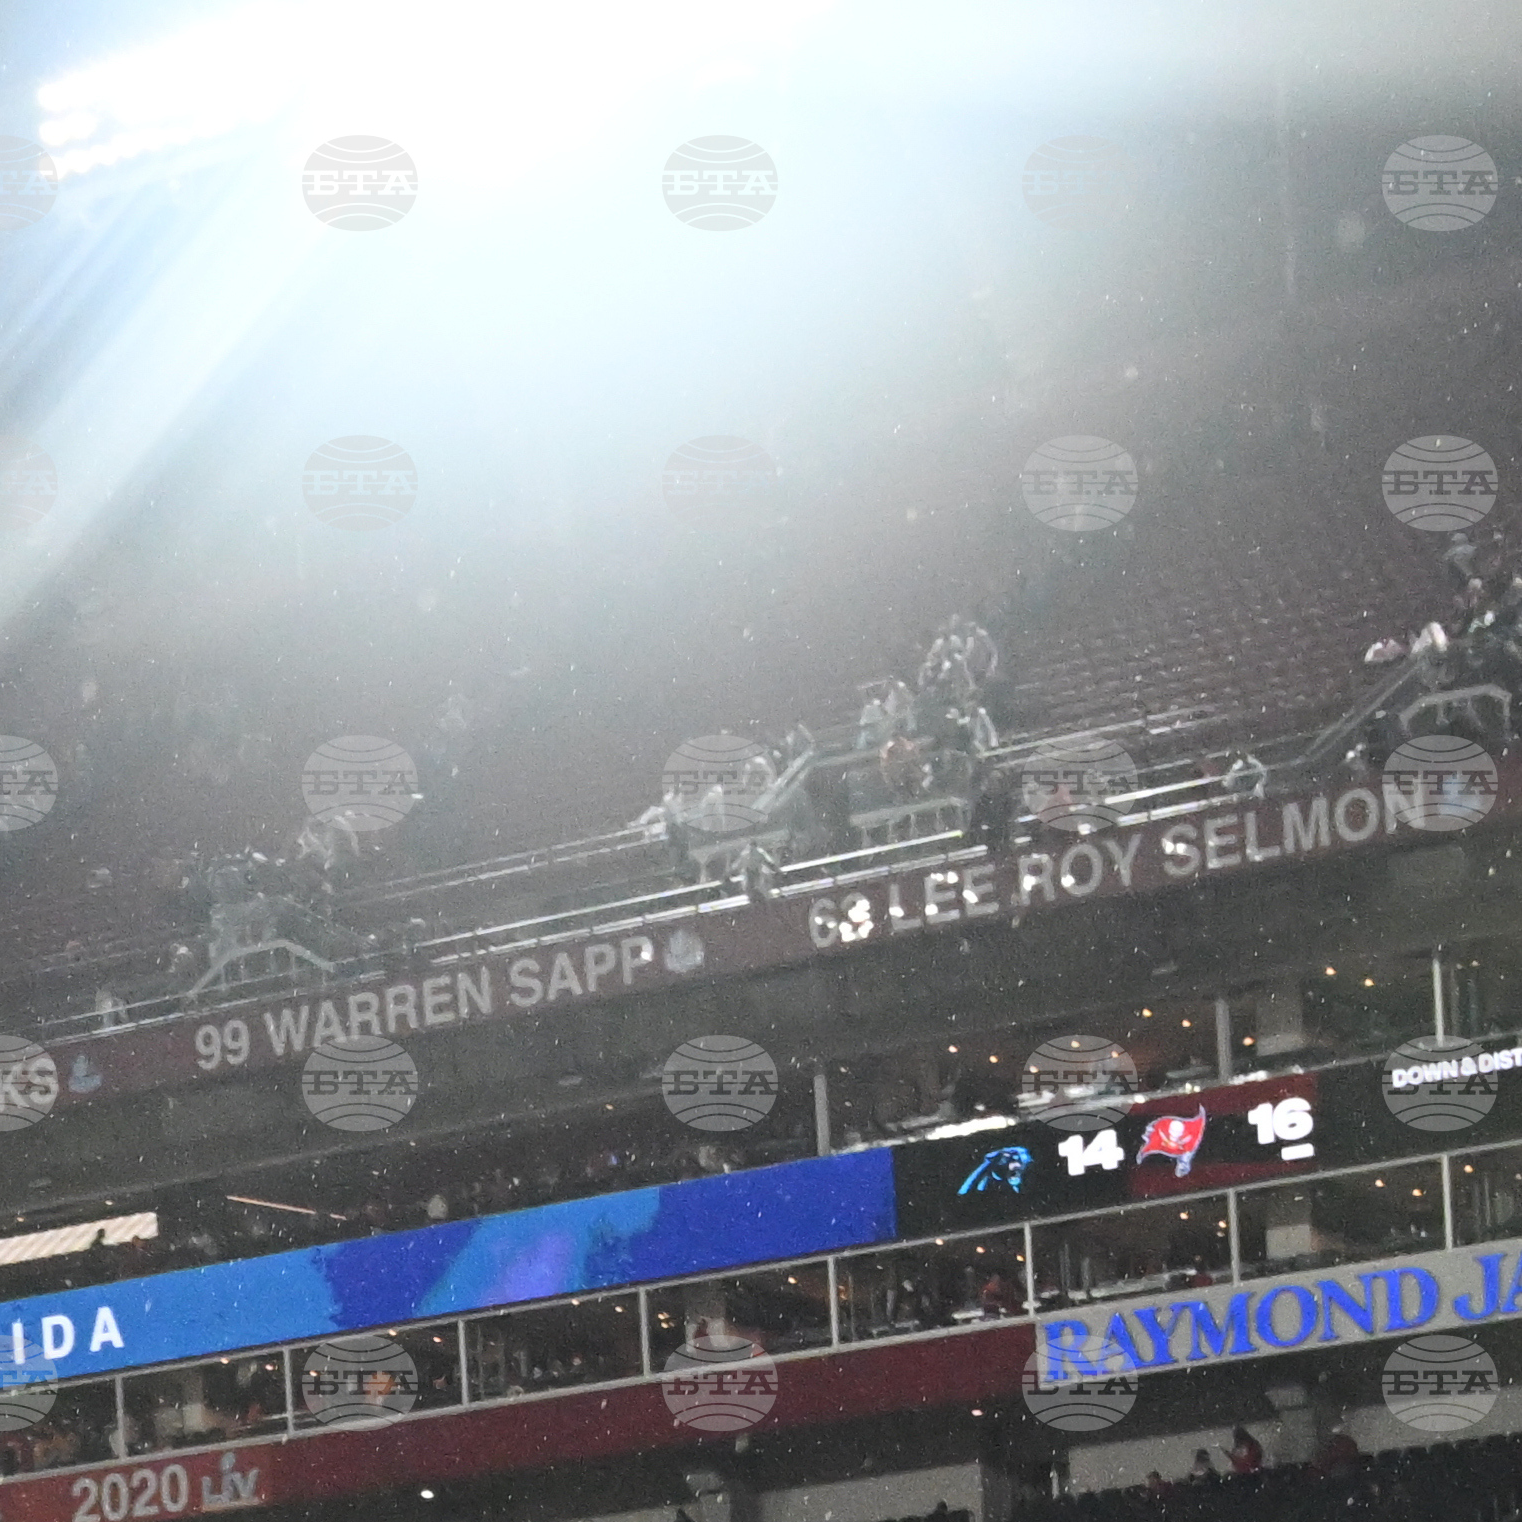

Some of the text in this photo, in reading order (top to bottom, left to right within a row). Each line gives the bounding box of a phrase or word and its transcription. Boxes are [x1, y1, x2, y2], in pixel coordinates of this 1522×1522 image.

[889, 864, 1000, 930] LEE
[1018, 835, 1145, 905] ROY
[194, 935, 653, 1071] 99 WARREN SAPP
[1391, 1058, 1459, 1088] DOWN
[1057, 1128, 1126, 1177] 14
[1247, 1097, 1314, 1147] 16
[1038, 1264, 1442, 1390] RAYMOND
